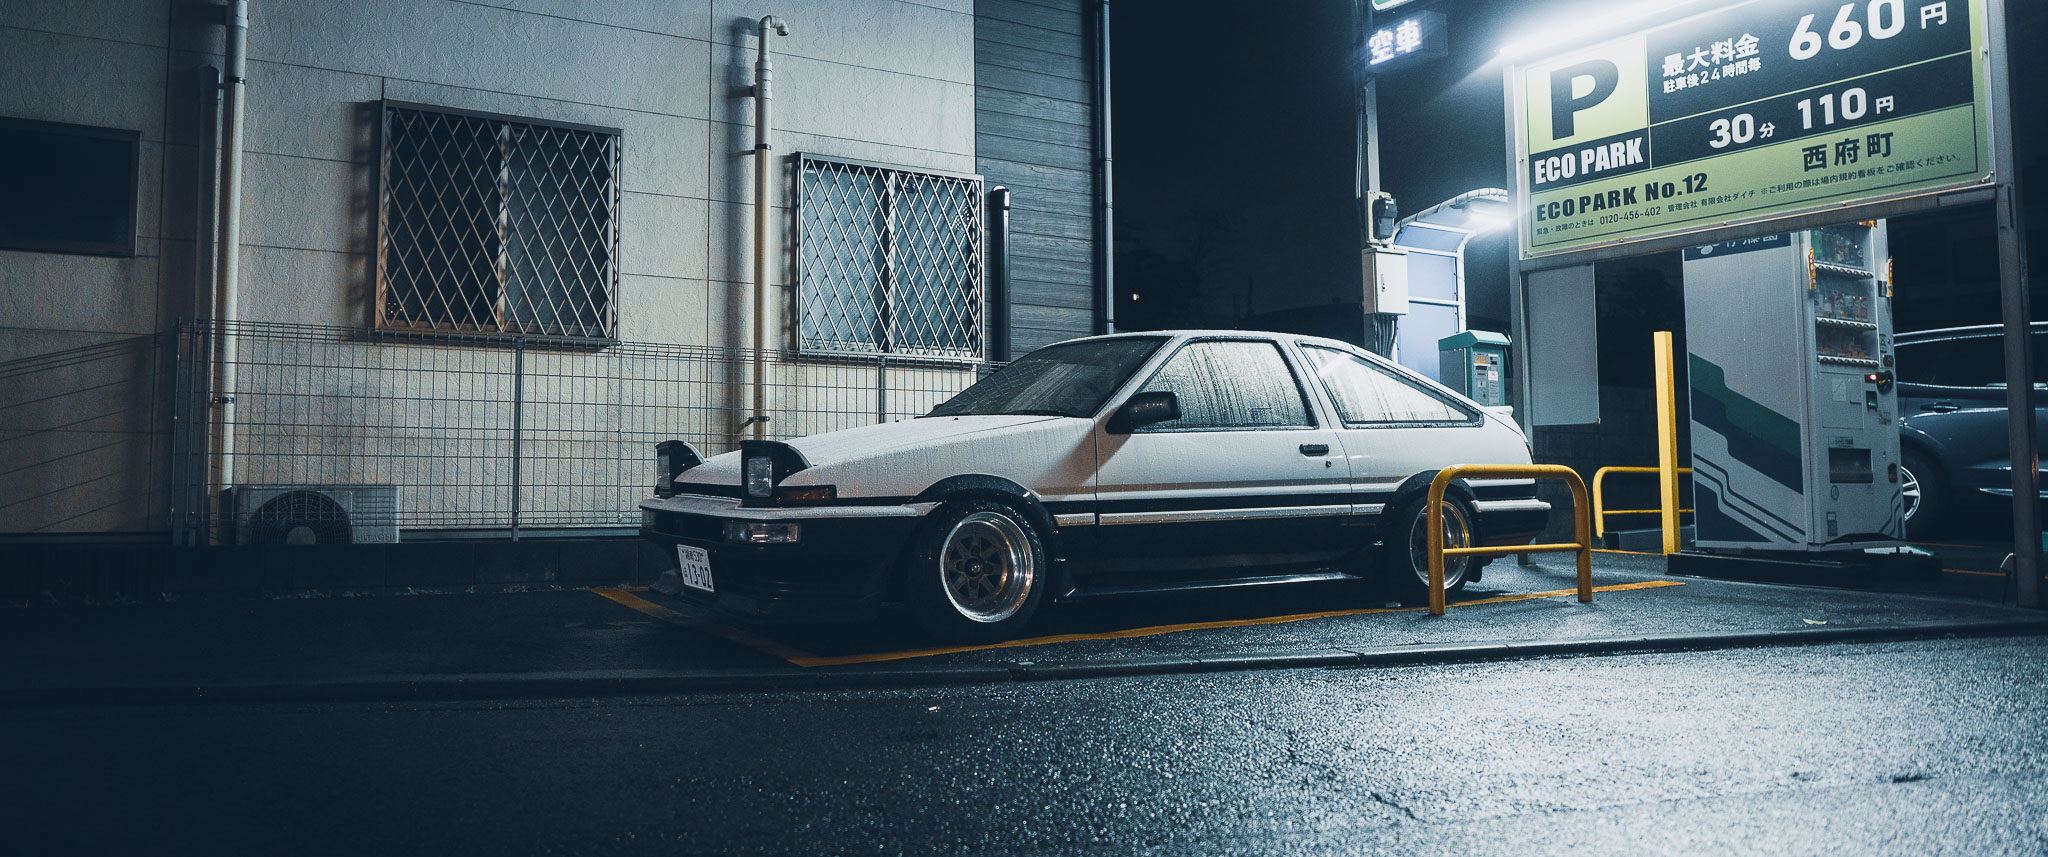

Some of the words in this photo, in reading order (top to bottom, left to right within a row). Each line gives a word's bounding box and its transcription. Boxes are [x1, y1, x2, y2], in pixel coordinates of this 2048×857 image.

[1369, 20, 1420, 65] 空車
[1662, 33, 1760, 77] 最大料金
[1663, 57, 1761, 94] 駐車後24時間毎
[1550, 59, 1619, 141] P
[1534, 153, 1576, 185] ECO
[1581, 137, 1644, 175] PARK
[1802, 132, 1894, 172] 西府町
[1645, 173, 1708, 201] No.12
[1600, 206, 1661, 225] 0120-456-402
[687, 563, 712, 589] 13-02
